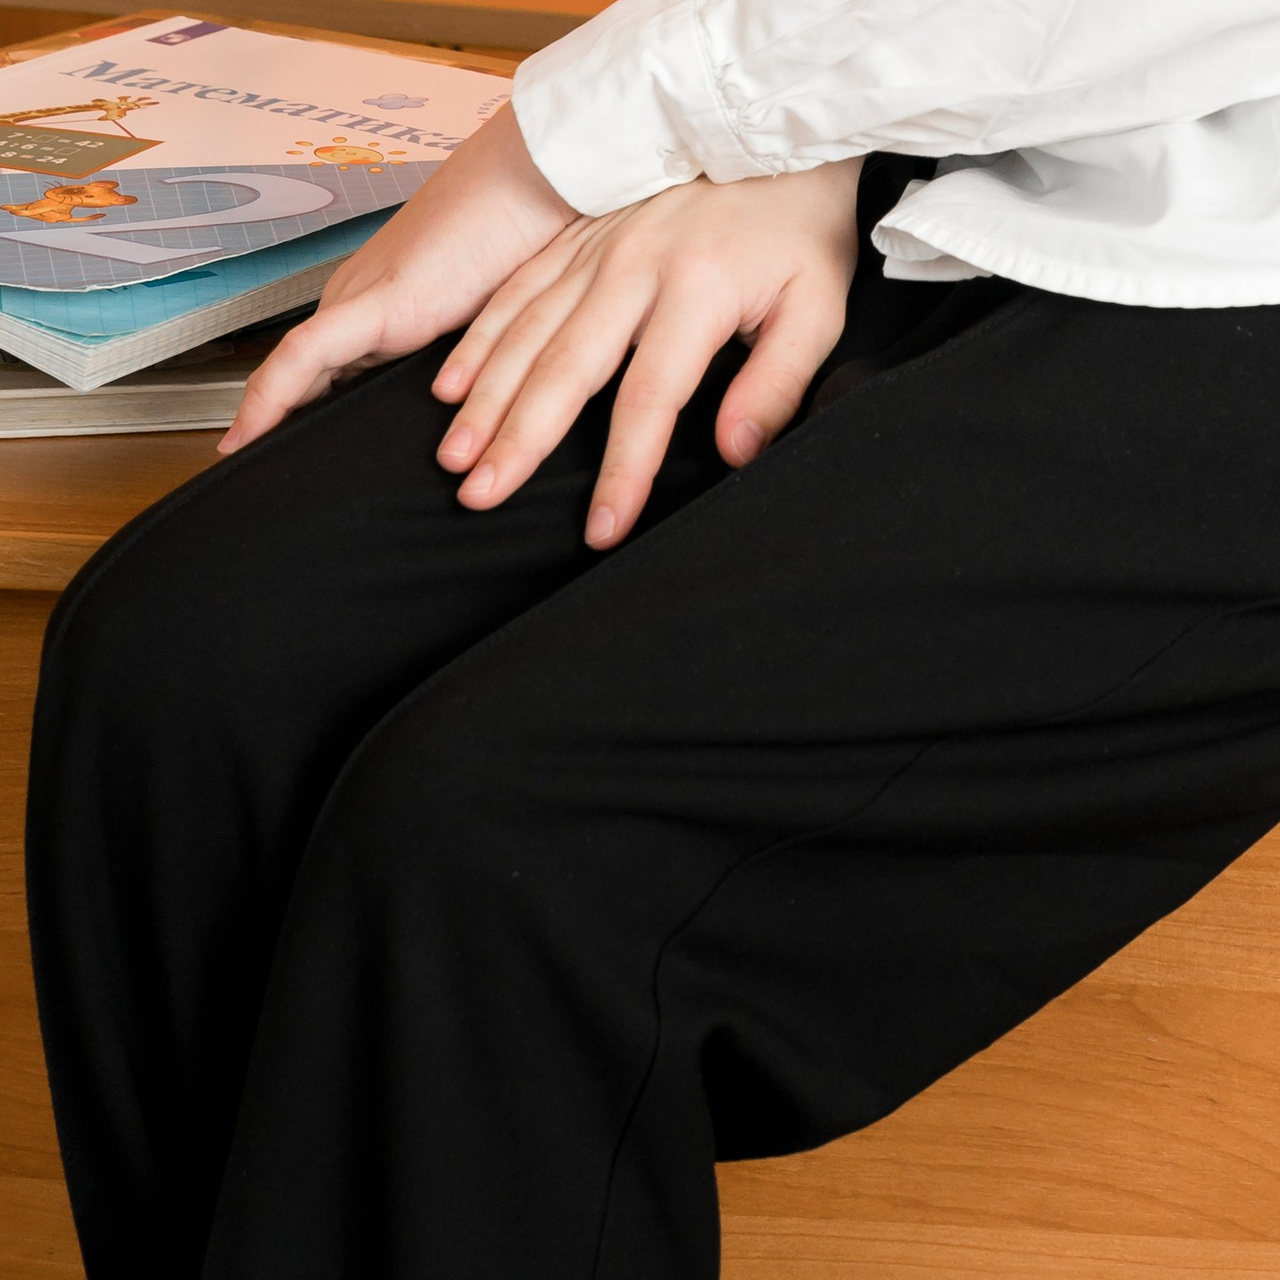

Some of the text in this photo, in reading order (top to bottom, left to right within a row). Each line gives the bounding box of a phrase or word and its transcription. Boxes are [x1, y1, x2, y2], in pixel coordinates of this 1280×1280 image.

[58, 60, 467, 152] Математика
[36, 155, 68, 165] 24
[0, 172, 335, 266] 2
